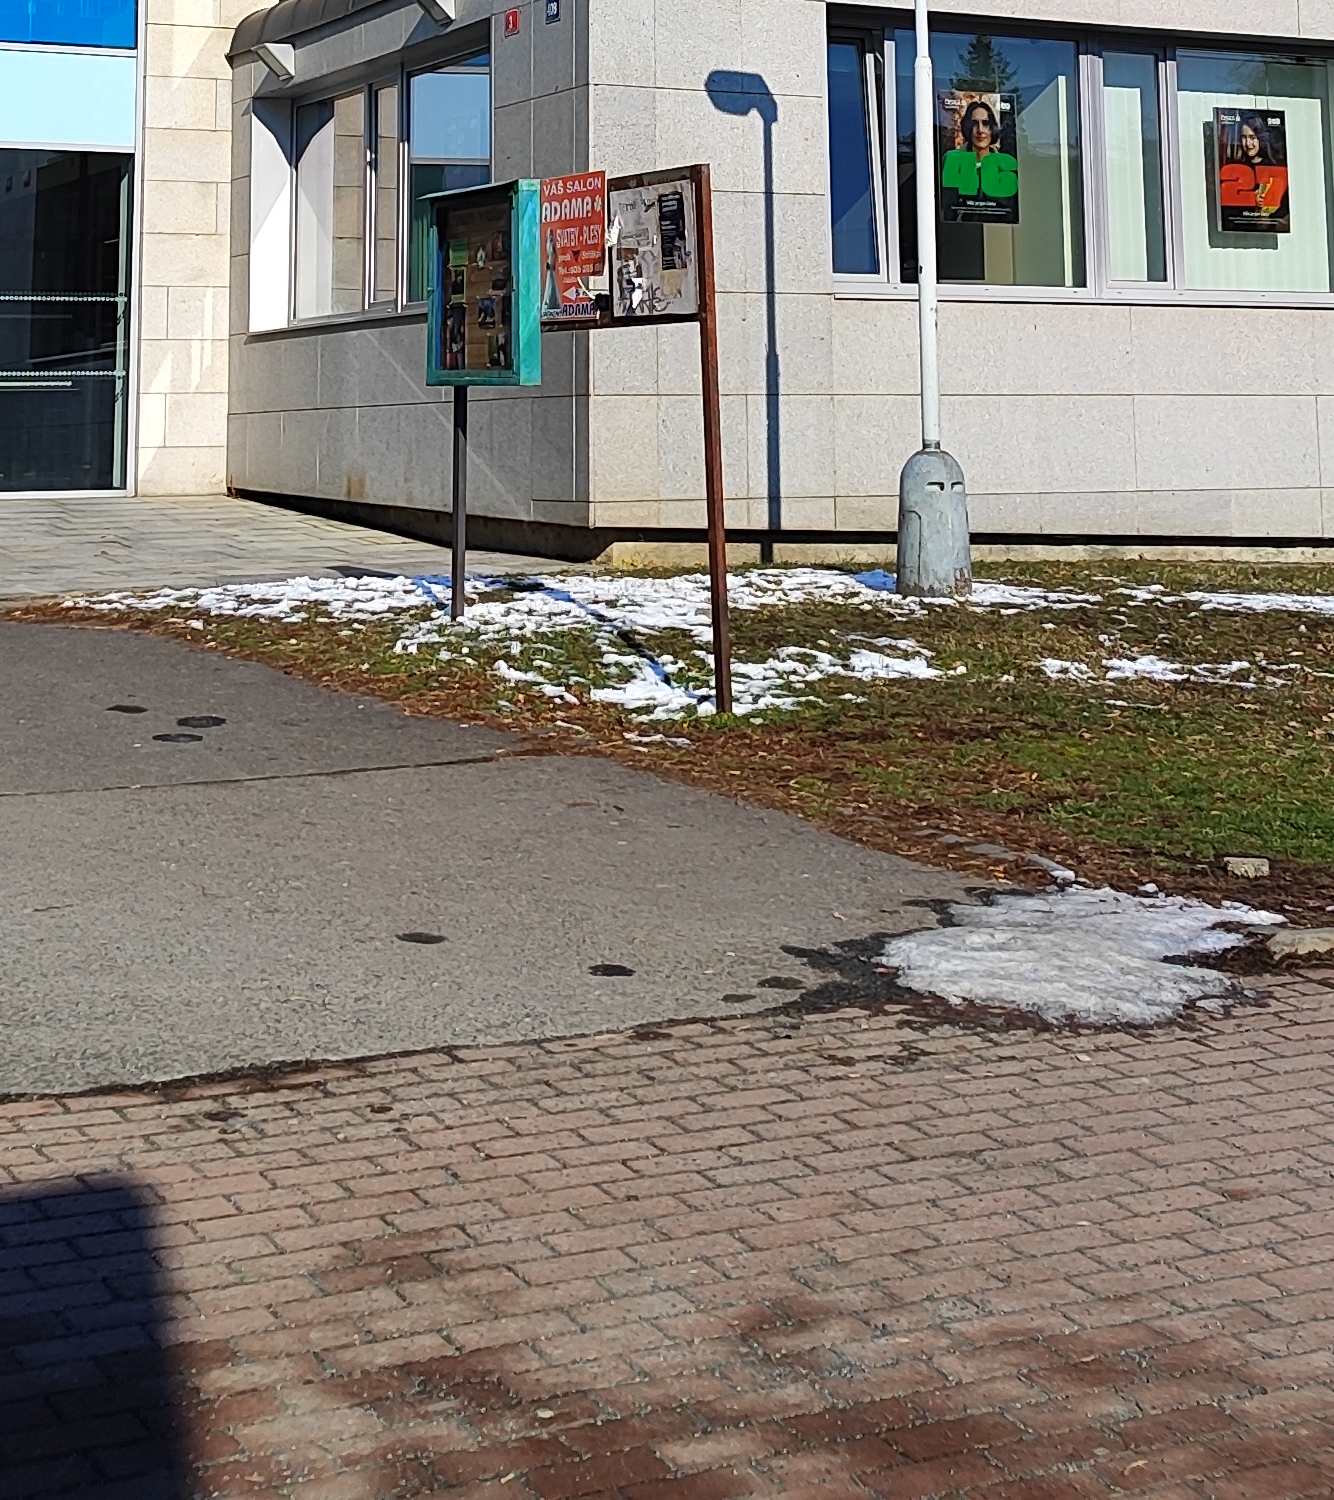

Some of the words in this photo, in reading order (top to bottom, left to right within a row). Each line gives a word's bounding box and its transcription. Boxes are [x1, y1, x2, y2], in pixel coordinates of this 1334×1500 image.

[565, 176, 602, 194] SALON
[942, 150, 1019, 198] 46
[1220, 163, 1288, 211] 27
[541, 195, 592, 224] ADAMA
